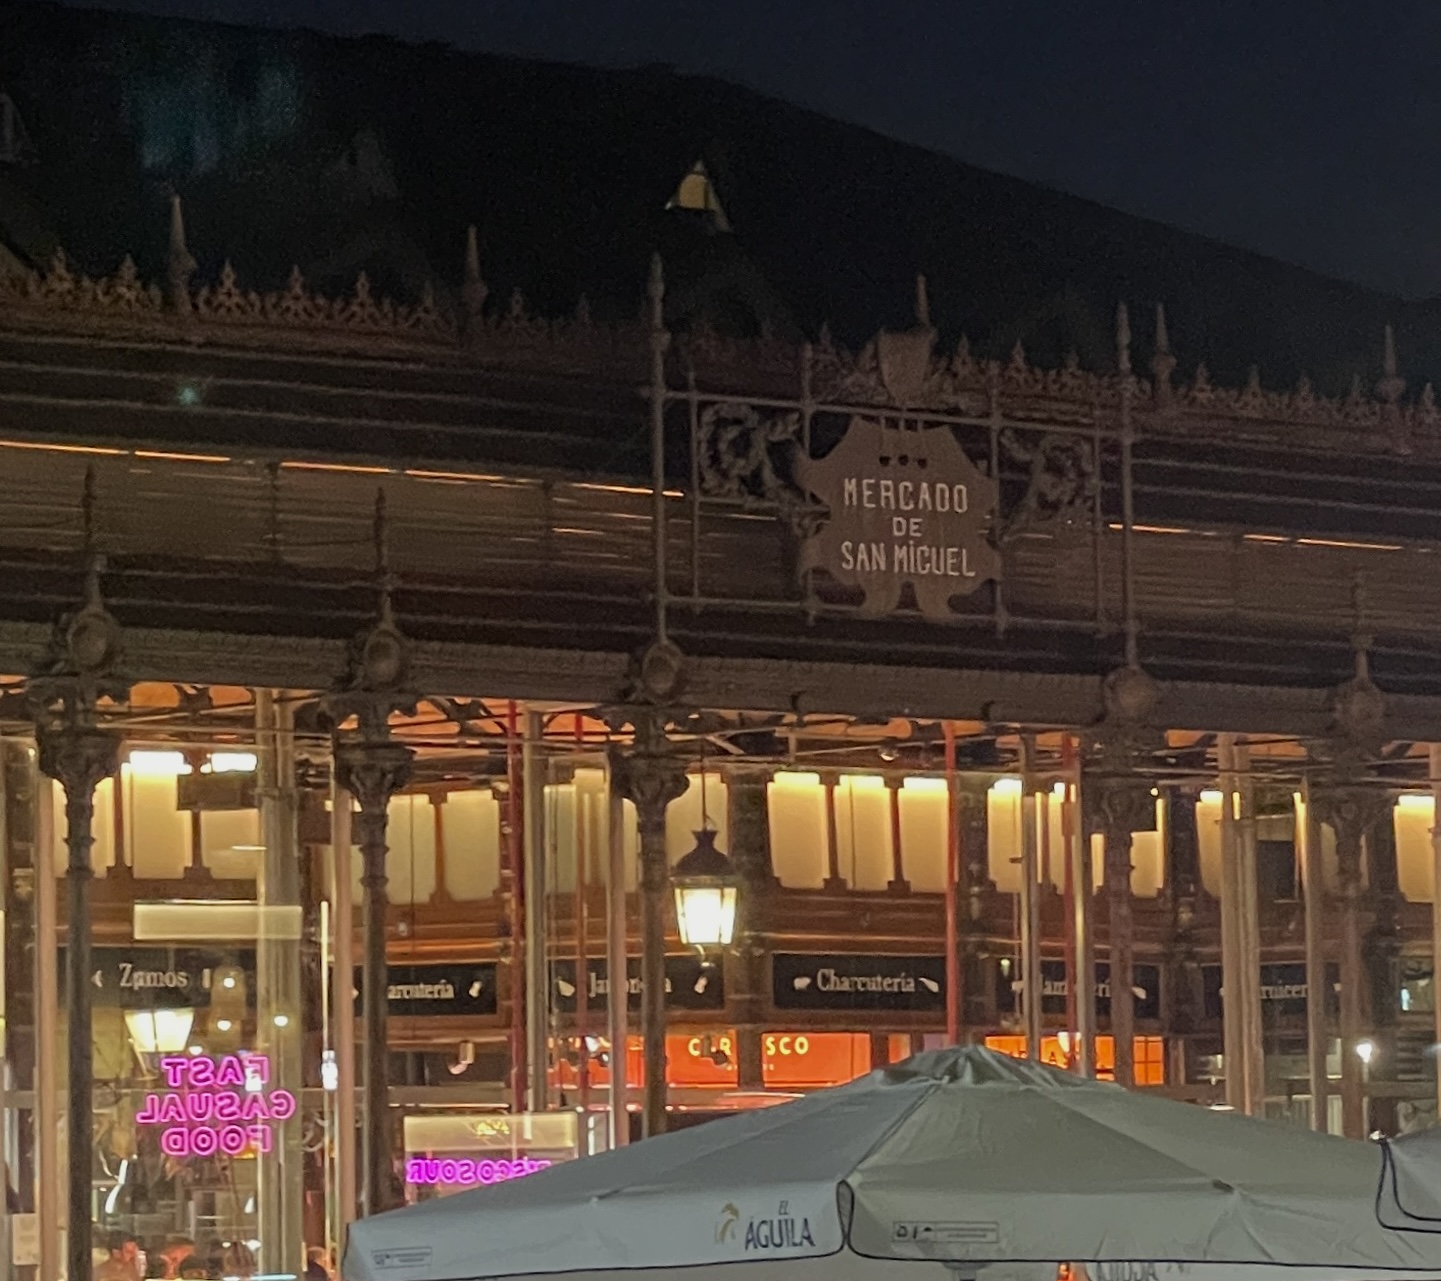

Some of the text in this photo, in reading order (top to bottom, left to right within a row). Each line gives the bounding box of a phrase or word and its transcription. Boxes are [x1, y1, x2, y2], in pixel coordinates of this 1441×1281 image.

[843, 478, 968, 513] MERCADO
[892, 517, 923, 538] DE
[841, 540, 975, 577] SAN MIGUEL
[816, 969, 915, 993] Charcutería
